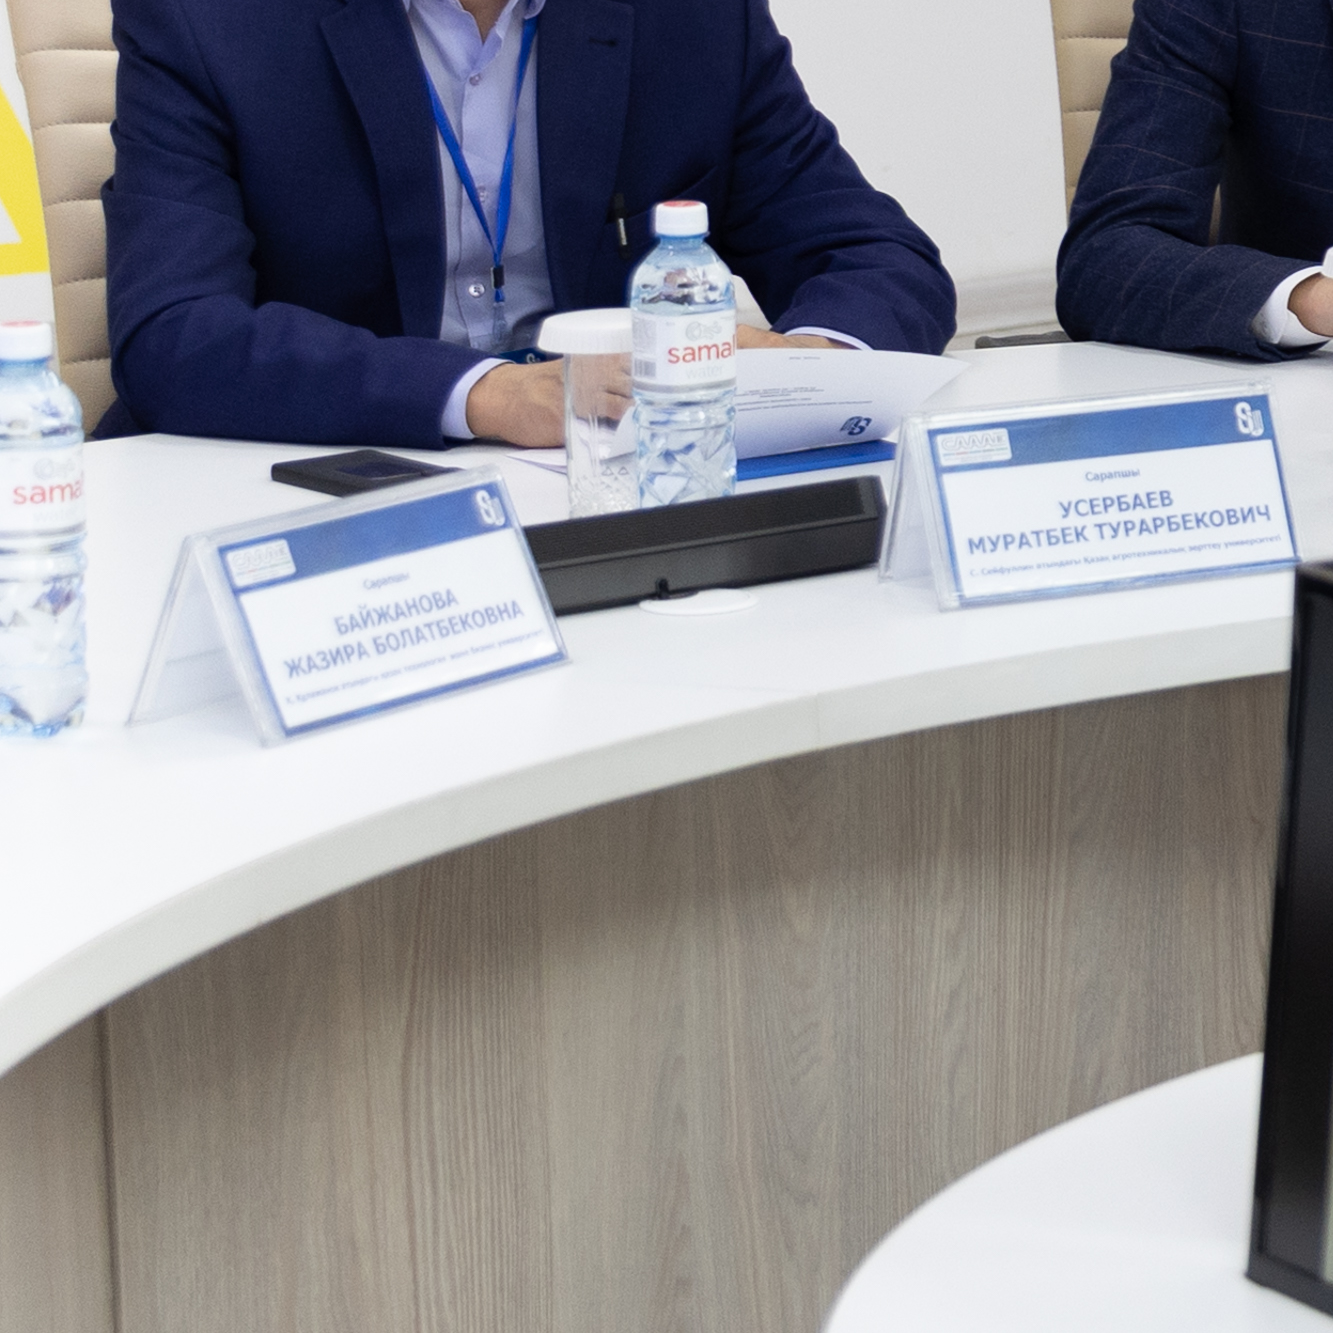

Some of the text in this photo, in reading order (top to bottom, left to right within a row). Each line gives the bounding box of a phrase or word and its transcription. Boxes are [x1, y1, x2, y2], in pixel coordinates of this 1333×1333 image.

[668, 334, 735, 364] samal
[13, 470, 84, 505] sama
[1085, 467, 1140, 482] Сарапшы
[1059, 489, 1174, 519] УСЕРБАЕВ
[967, 504, 1272, 556] МУРАТБЕК ТУРАРБЕКОВИЧ
[334, 588, 460, 636] БАЙЖАНОВА
[283, 600, 525, 679] ЖАЗИРА БОЛАТБЕКОВНА
